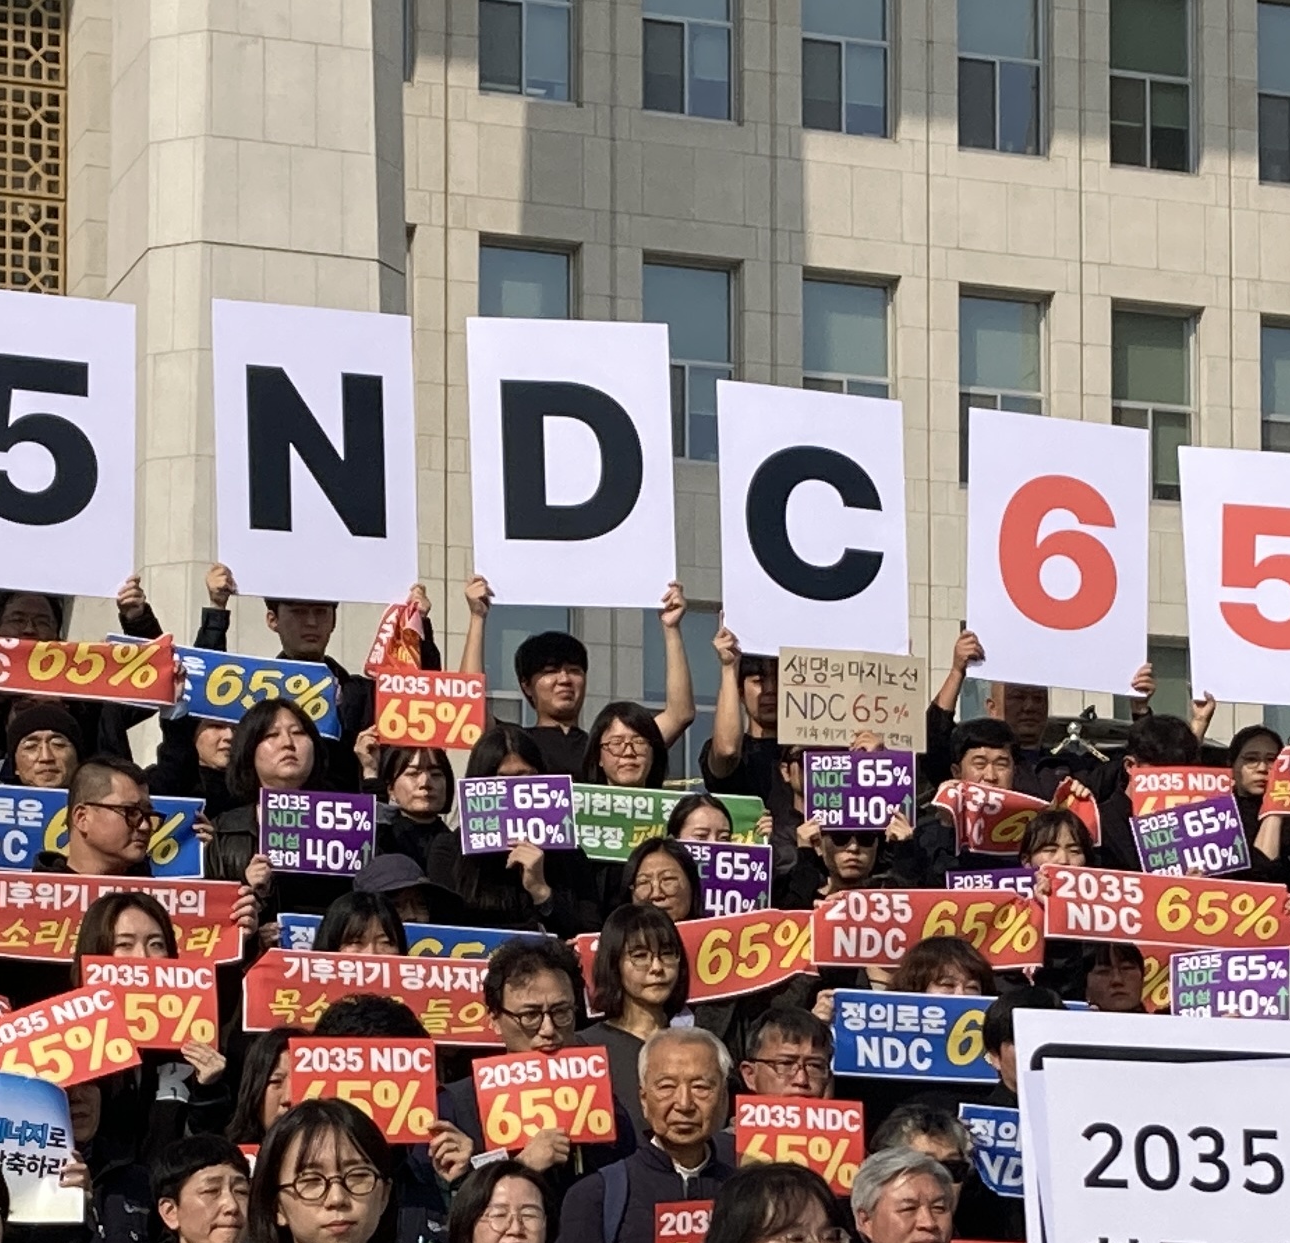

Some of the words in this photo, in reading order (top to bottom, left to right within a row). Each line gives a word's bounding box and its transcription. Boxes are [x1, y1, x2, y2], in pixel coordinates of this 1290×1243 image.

[28, 642, 161, 690] 65%
[784, 655, 844, 684] 생명의
[848, 661, 918, 691] 마지노선
[379, 673, 430, 695] 2035
[435, 677, 482, 698] NDC
[377, 698, 482, 747] 65%
[786, 691, 847, 721] NDC
[852, 693, 910, 724] 65%
[810, 756, 852, 772] 2035
[857, 758, 911, 787] 65%
[465, 781, 507, 797] 2035
[513, 782, 570, 809] 65%
[1135, 774, 1183, 792] 2035
[1188, 774, 1230, 792] NDC
[268, 793, 310, 810] 2035
[812, 792, 843, 808] 여성
[315, 800, 372, 831] 65%
[469, 814, 500, 831] 여성
[268, 832, 300, 849] 여성
[306, 841, 362, 870] 40%
[470, 832, 502, 849] 참여
[268, 850, 300, 867] 참여
[715, 851, 767, 882] 65%
[1056, 870, 1143, 903] 2035
[825, 892, 912, 924] 2035
[1067, 902, 1142, 935] NDC
[1157, 886, 1279, 941] 65%
[832, 927, 907, 960] NDC
[156, 966, 213, 990] NDC
[283, 956, 392, 989] 기후위기
[1178, 954, 1222, 972] 2035
[1228, 953, 1287, 981] 65%
[52, 989, 115, 1023] NDC
[841, 1001, 947, 1036] 정의로운
[295, 1047, 363, 1073] 2035
[370, 1048, 433, 1074] NDC
[856, 1037, 932, 1071] NDC
[478, 1060, 542, 1090] 2035
[548, 1055, 606, 1081] NDC
[486, 1085, 612, 1145] 65%
[739, 1104, 801, 1128] 2035
[806, 1107, 860, 1133] NDC
[1080, 1121, 1286, 1195] 2035
